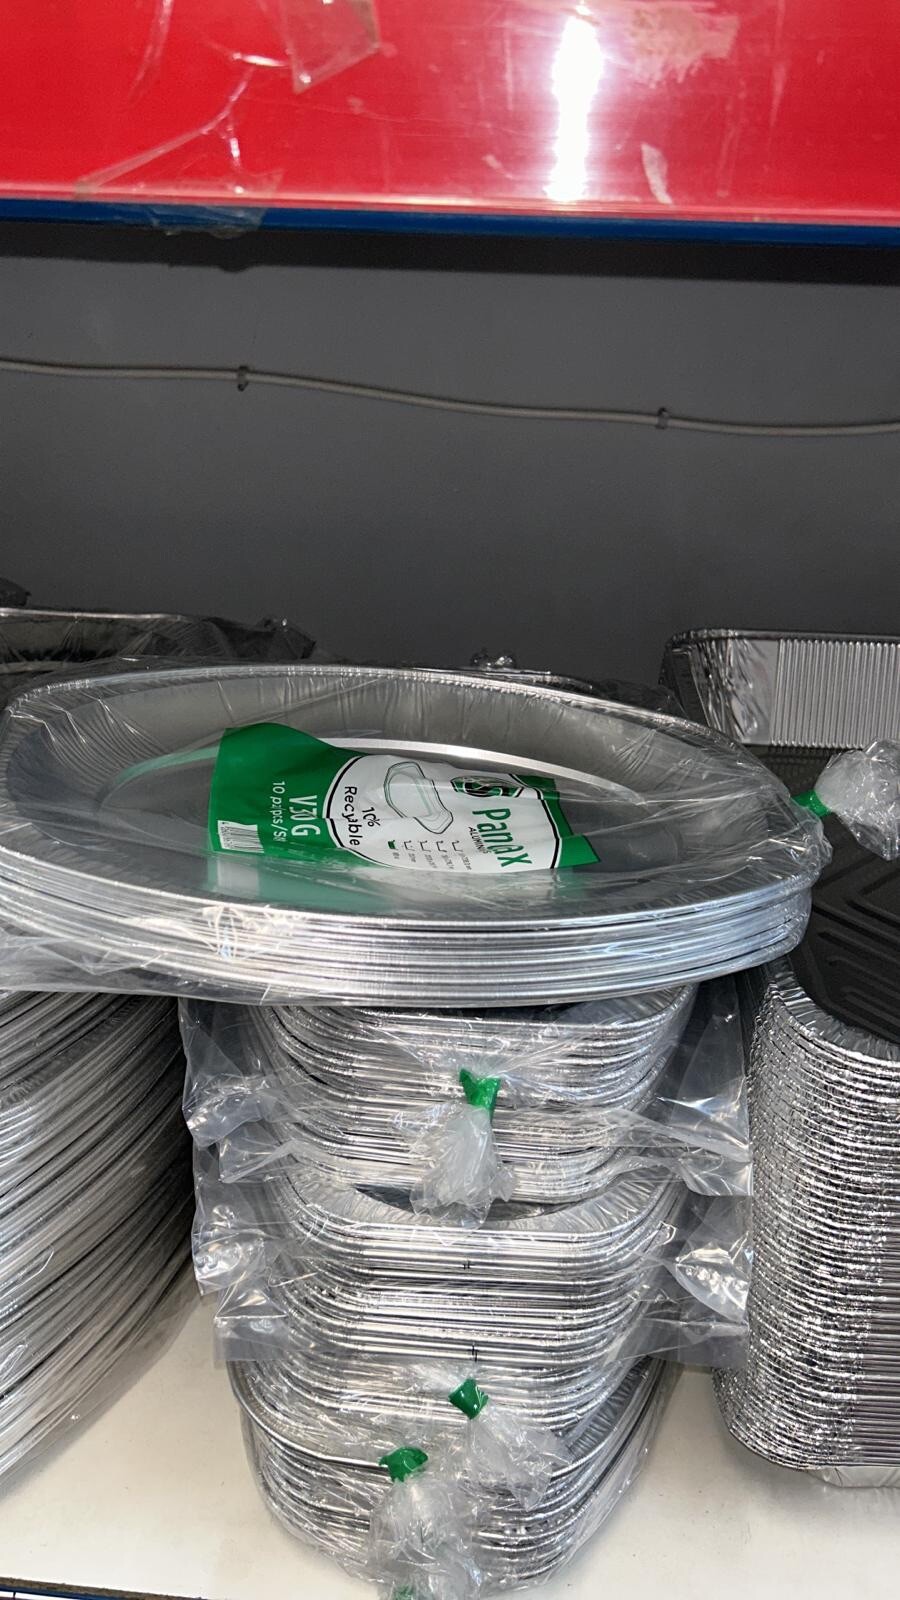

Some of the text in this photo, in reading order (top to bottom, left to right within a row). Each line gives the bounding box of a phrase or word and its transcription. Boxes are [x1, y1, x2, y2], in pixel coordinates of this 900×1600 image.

[272, 781, 286, 794] 10
[291, 824, 320, 836] G
[472, 808, 532, 867] Panax
